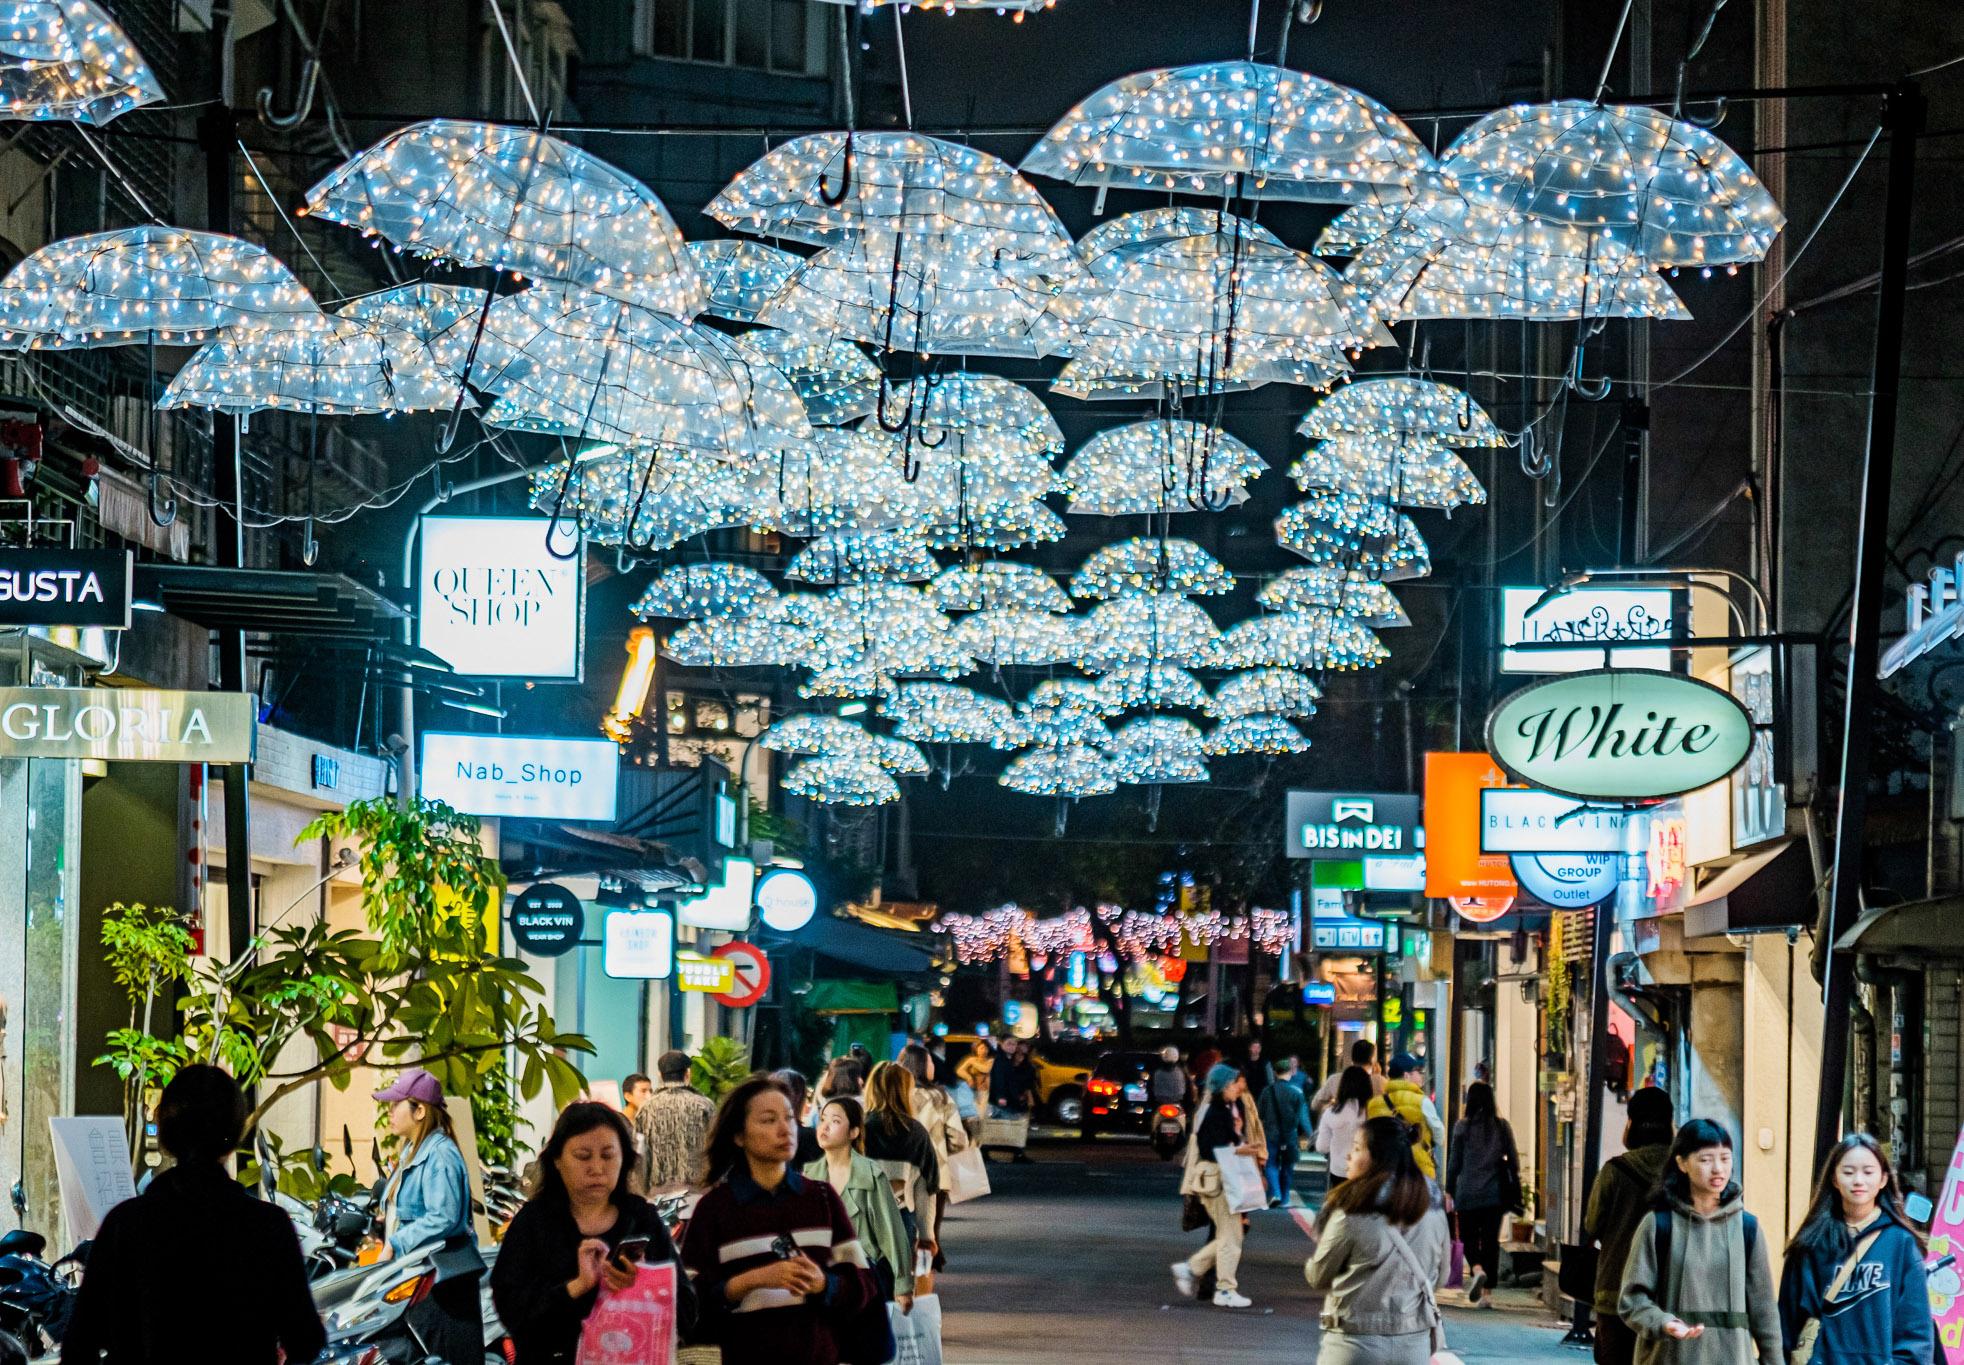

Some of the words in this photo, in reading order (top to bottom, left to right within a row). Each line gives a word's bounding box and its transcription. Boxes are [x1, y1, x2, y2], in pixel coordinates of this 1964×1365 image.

[0, 570, 104, 603] GUSTA
[433, 567, 556, 601] QUEEN
[450, 598, 540, 626] SHOP
[2, 702, 213, 744] GLORIA
[1517, 703, 1720, 762] White
[457, 761, 582, 787] Nab_Shop
[1579, 815, 1618, 828] VIN
[1557, 867, 1602, 877] GROUP
[1553, 889, 1590, 899] Outlet
[519, 916, 553, 926] BLACK
[553, 916, 574, 926] VIN
